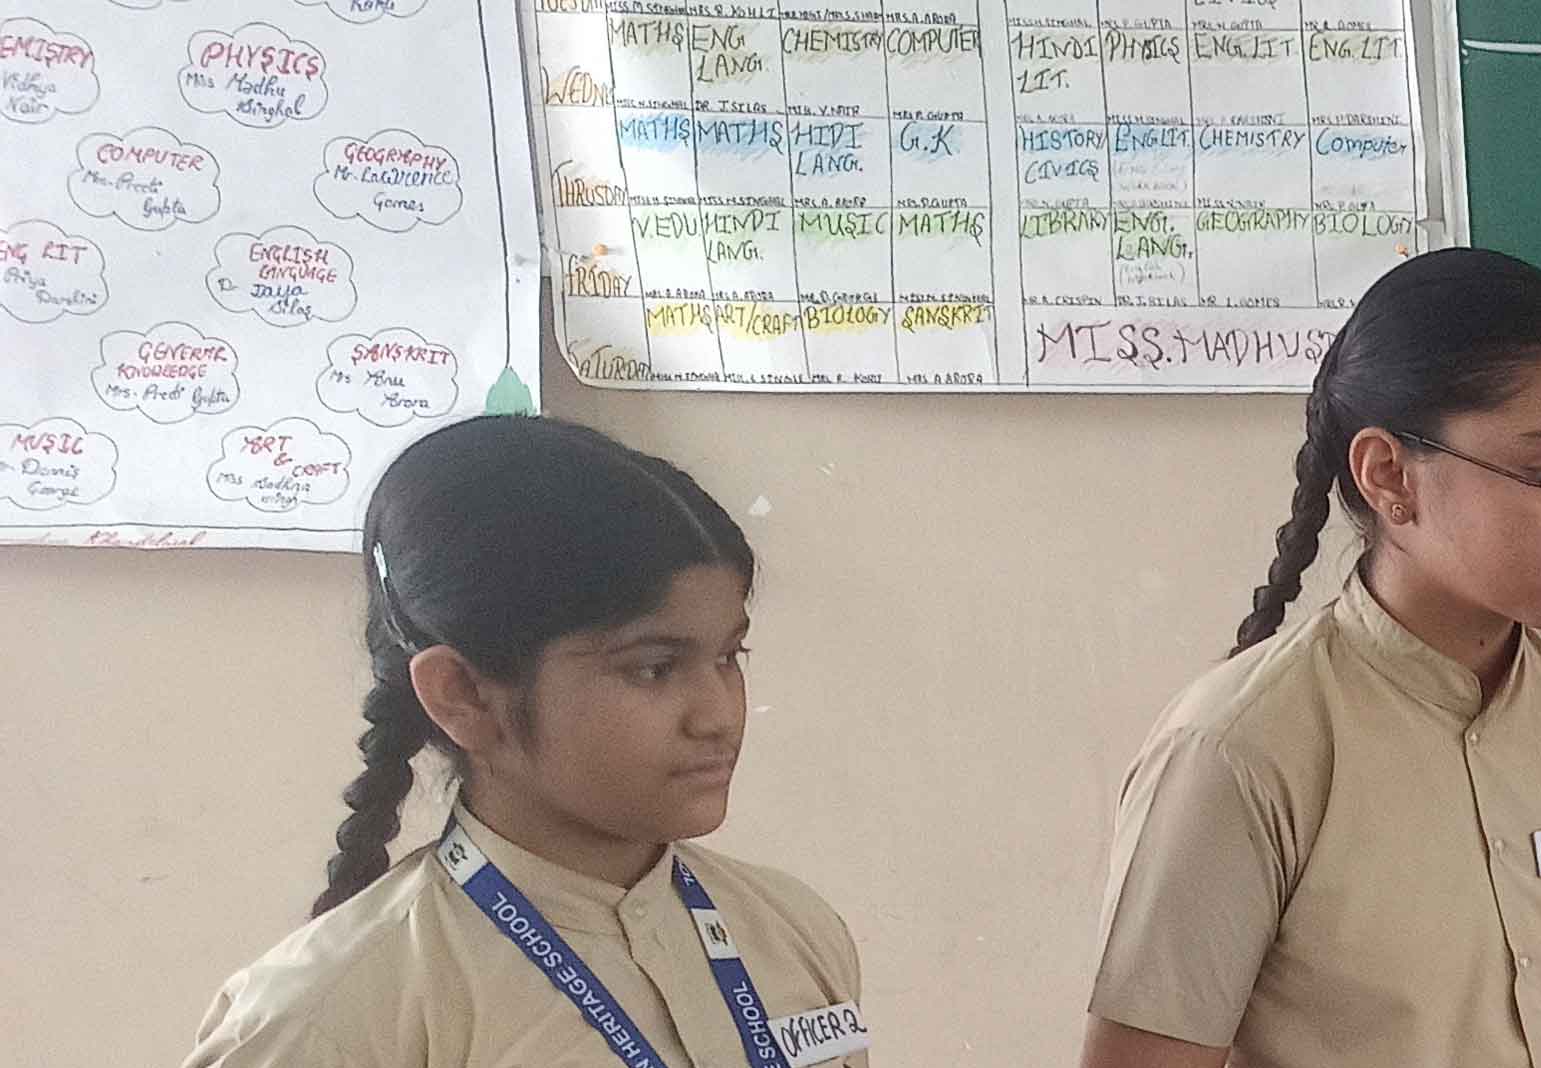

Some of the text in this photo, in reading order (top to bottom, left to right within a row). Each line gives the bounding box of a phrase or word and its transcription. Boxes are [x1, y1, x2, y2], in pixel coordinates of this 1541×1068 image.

[609, 17, 685, 52] MATHS
[782, 28, 882, 54] CHEMISTRY
[887, 26, 980, 56] COMPUTER
[1011, 31, 1098, 60] HINDI
[199, 42, 320, 80] PHYSICS
[226, 73, 286, 98] Madhu
[1017, 67, 1070, 93] LIT.
[619, 118, 691, 147] MATHS
[697, 120, 784, 155] MATHS
[791, 120, 864, 149] HIDI
[1199, 125, 1305, 151] CHEMISTRY
[97, 143, 205, 171] COMPUTER
[1025, 159, 1100, 184] CIVICS
[703, 208, 782, 235] HINDI
[799, 211, 889, 239] MUSIC
[899, 210, 985, 247] MATHS
[1021, 211, 1107, 240] LIBRARY
[1196, 209, 1308, 233] GEOGRAPHY
[1314, 212, 1412, 237] BIOLOGY
[249, 243, 328, 266] ENGLISH
[258, 264, 336, 283] LANGUAGE
[646, 303, 713, 334] MATHS
[902, 303, 992, 333] SANSKRIT
[138, 341, 228, 364] GENERAL
[351, 342, 450, 366] SANSKRIT
[11, 432, 84, 456] MUSIC
[491, 891, 564, 969] SCHOOL
[557, 965, 642, 1060] HERITAGE
[733, 981, 776, 1060] SCHOOL
[780, 1008, 867, 1058] OFFICER 2
